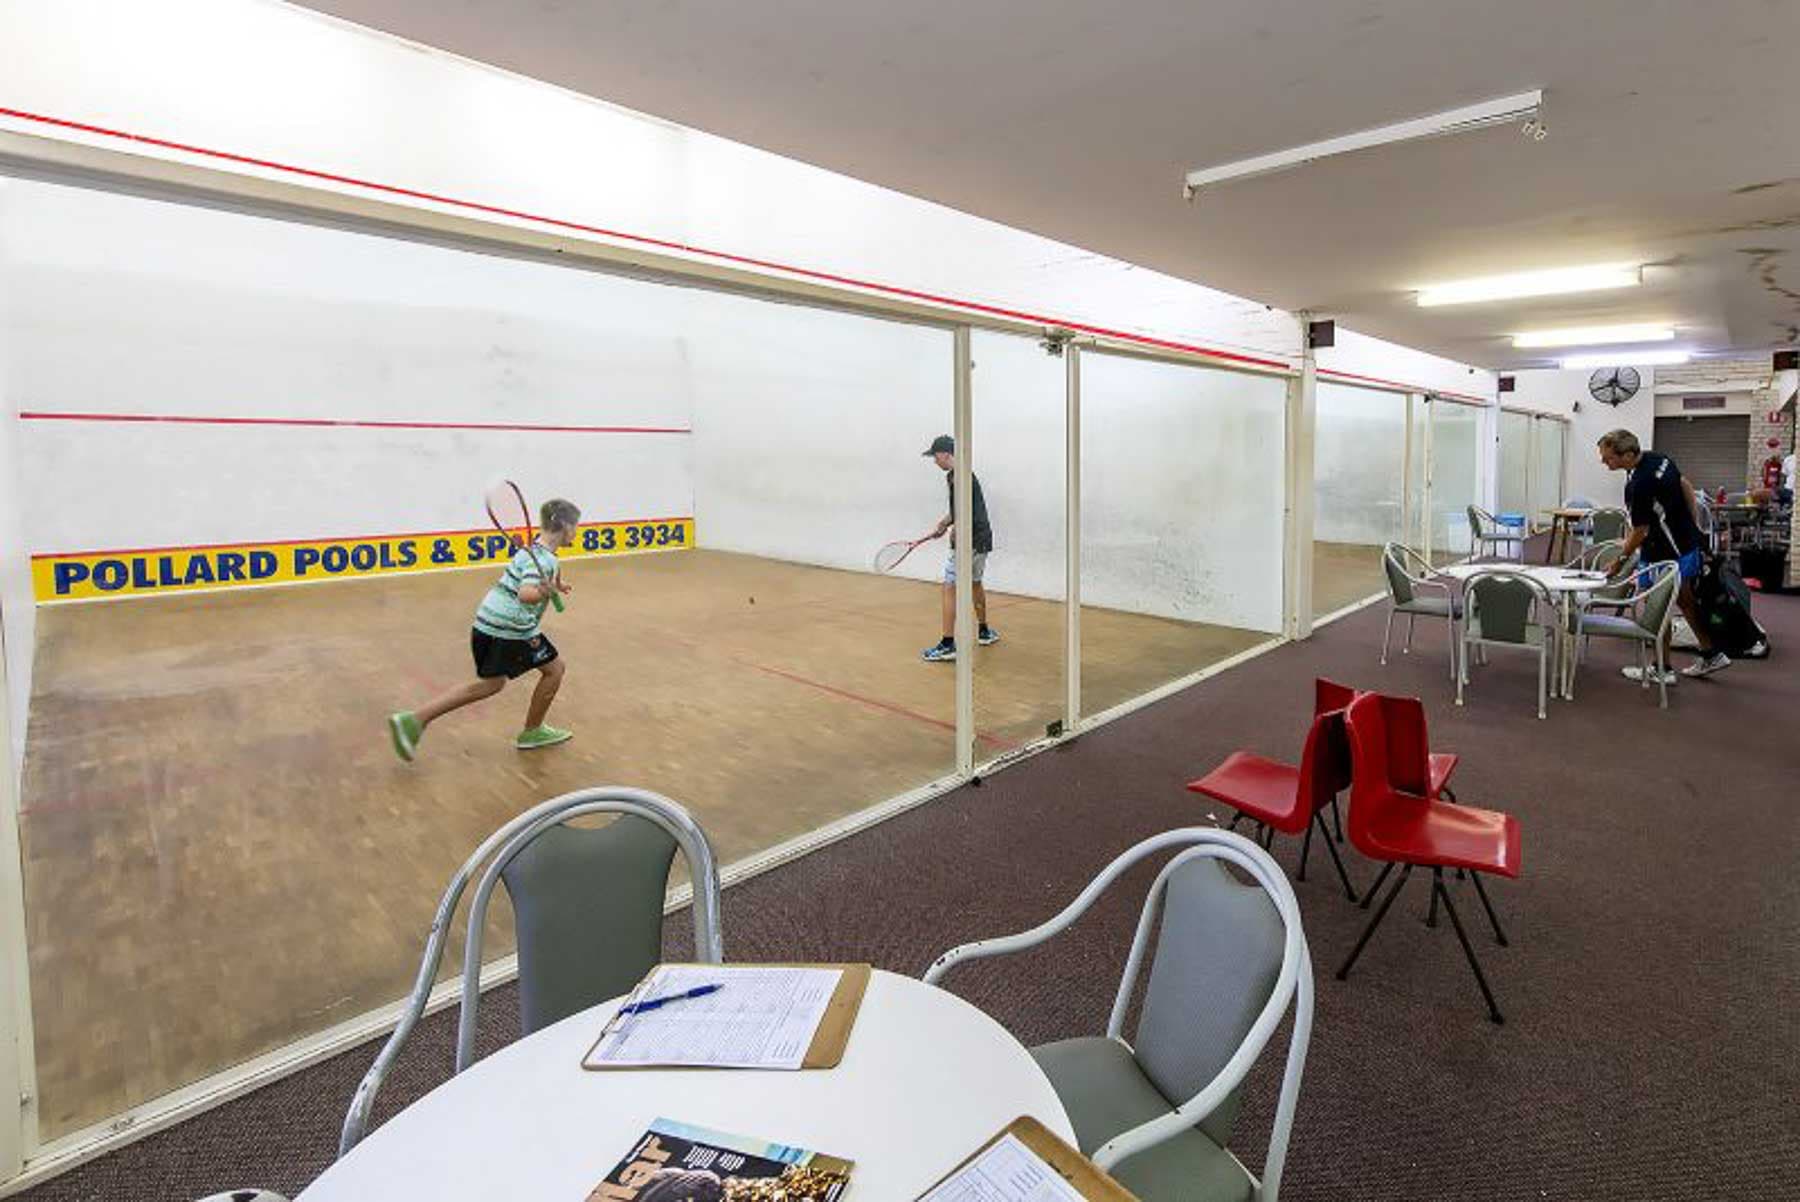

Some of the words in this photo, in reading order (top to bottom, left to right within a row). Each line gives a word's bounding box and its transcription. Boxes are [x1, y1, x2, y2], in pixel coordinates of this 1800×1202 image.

[54, 550, 278, 595] POLLARD
[294, 540, 417, 577] POOLS
[431, 539, 457, 563] &
[582, 528, 617, 550] 83
[625, 524, 685, 547] 3934
